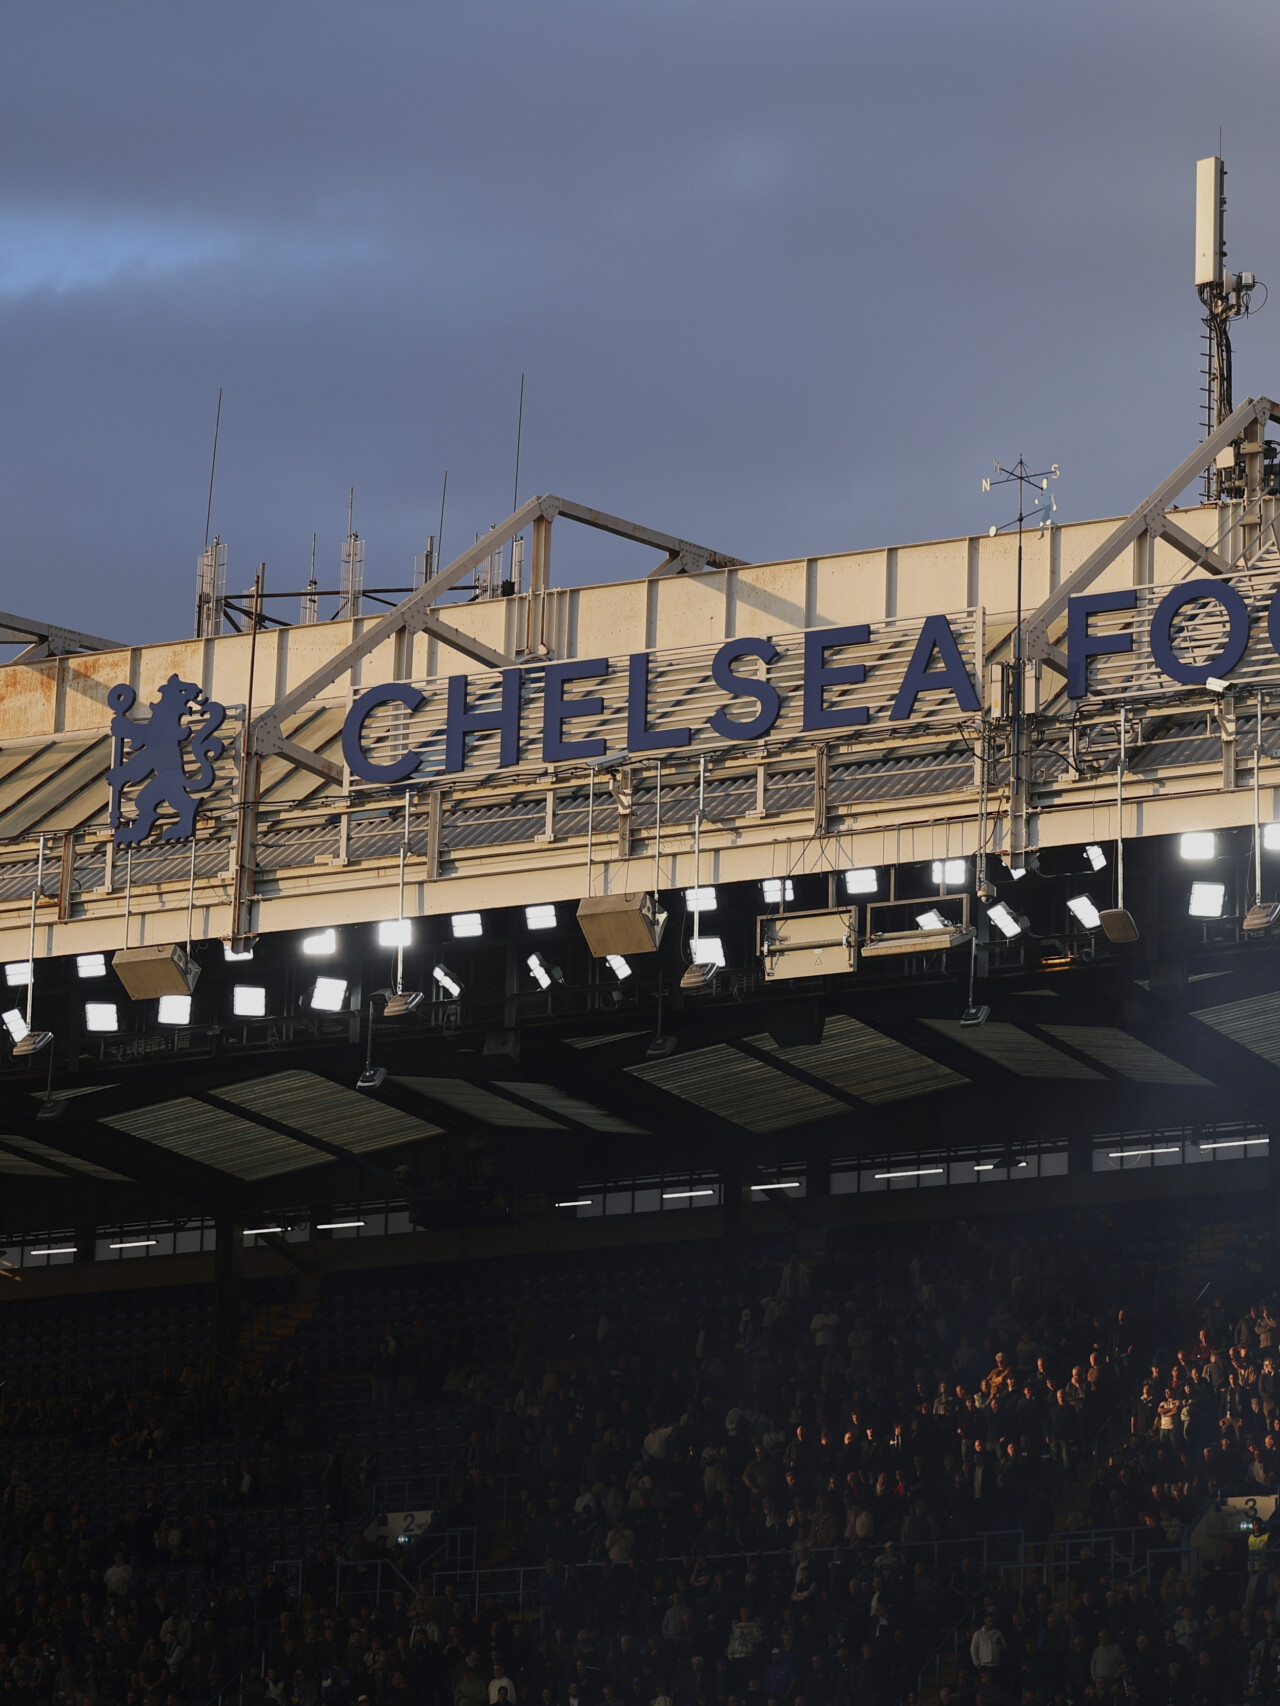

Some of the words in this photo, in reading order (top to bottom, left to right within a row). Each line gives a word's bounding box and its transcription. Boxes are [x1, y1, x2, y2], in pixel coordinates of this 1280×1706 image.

[1051, 464, 1060, 479] S
[982, 478, 991, 492] N
[342, 613, 982, 784] CHELSEA
[1245, 1498, 1258, 1518] 3
[403, 1513, 416, 1532] 2
